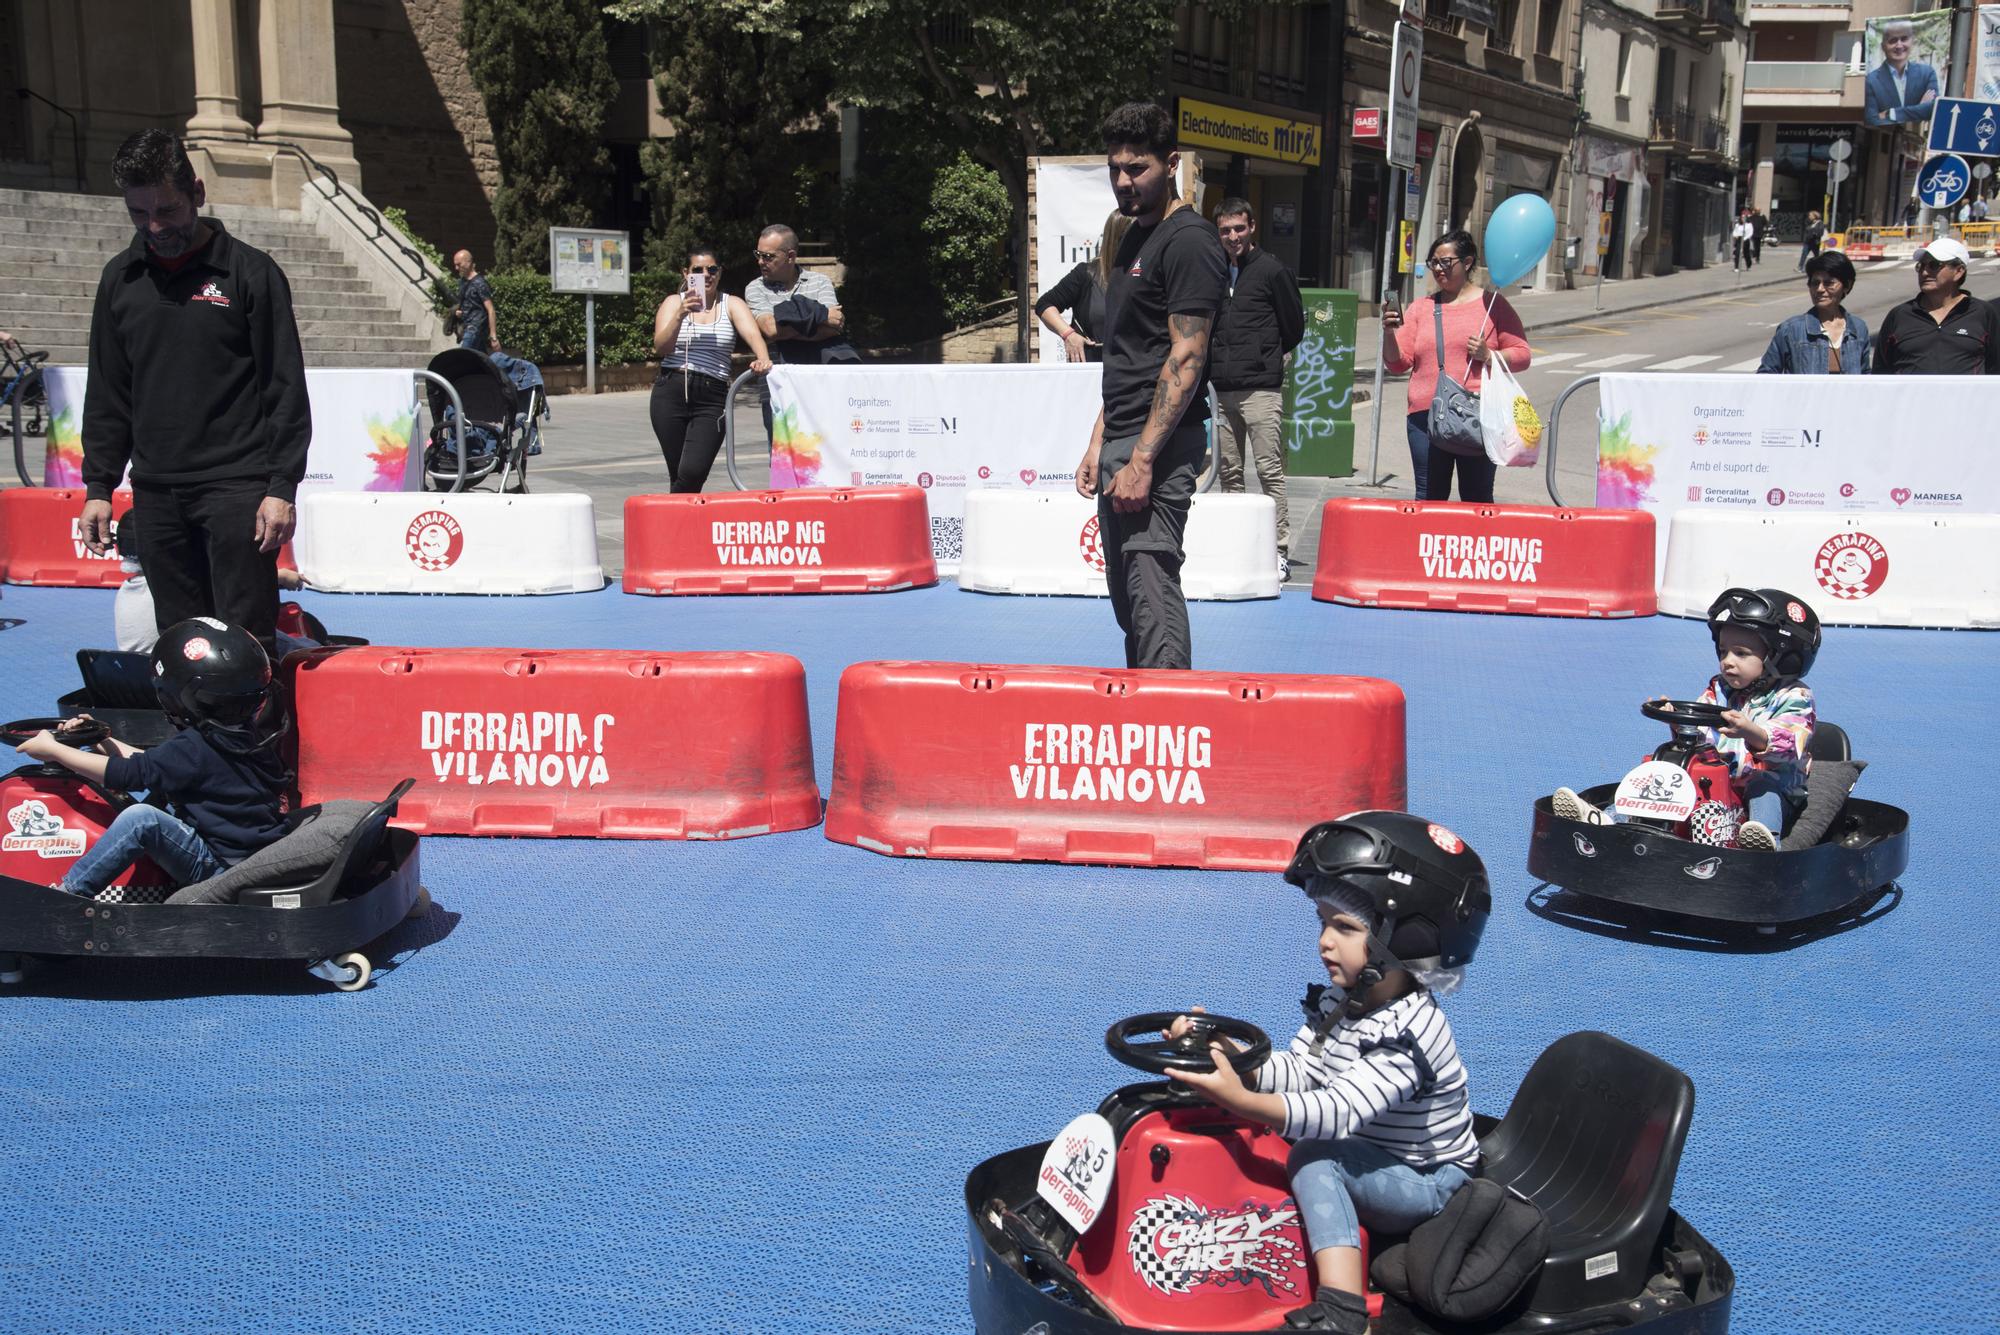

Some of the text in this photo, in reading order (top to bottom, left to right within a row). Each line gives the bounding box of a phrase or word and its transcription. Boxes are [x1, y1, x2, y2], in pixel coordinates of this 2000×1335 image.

[1355, 117, 1378, 126] GAES
[1182, 112, 1269, 146] Electrodomèstics
[849, 397, 892, 408] Organitzen:
[1694, 406, 1744, 418] Organitzen:
[1713, 430, 1751, 438] Ajuntament
[850, 448, 917, 459] Amb el suport de:
[1690, 461, 1769, 474] Amb el suport de:
[1705, 487, 1749, 496] Generalitat
[1789, 491, 1825, 499] Diputació
[1913, 493, 1962, 501] MANRESA
[1717, 496, 1757, 505] Catalunya
[1789, 498, 1825, 506] Barcelona
[1419, 533, 1543, 563] DERRAPING
[717, 545, 823, 565] VILANOVA
[1423, 557, 1537, 582] VILANOVA
[431, 751, 610, 788] VILANOVA
[1009, 764, 1205, 804] VILANOVA
[1671, 774, 1683, 788] 2
[1093, 1148, 1108, 1173] 5
[1159, 1210, 1297, 1248] CRAZY
[1162, 1242, 1258, 1272] CART
